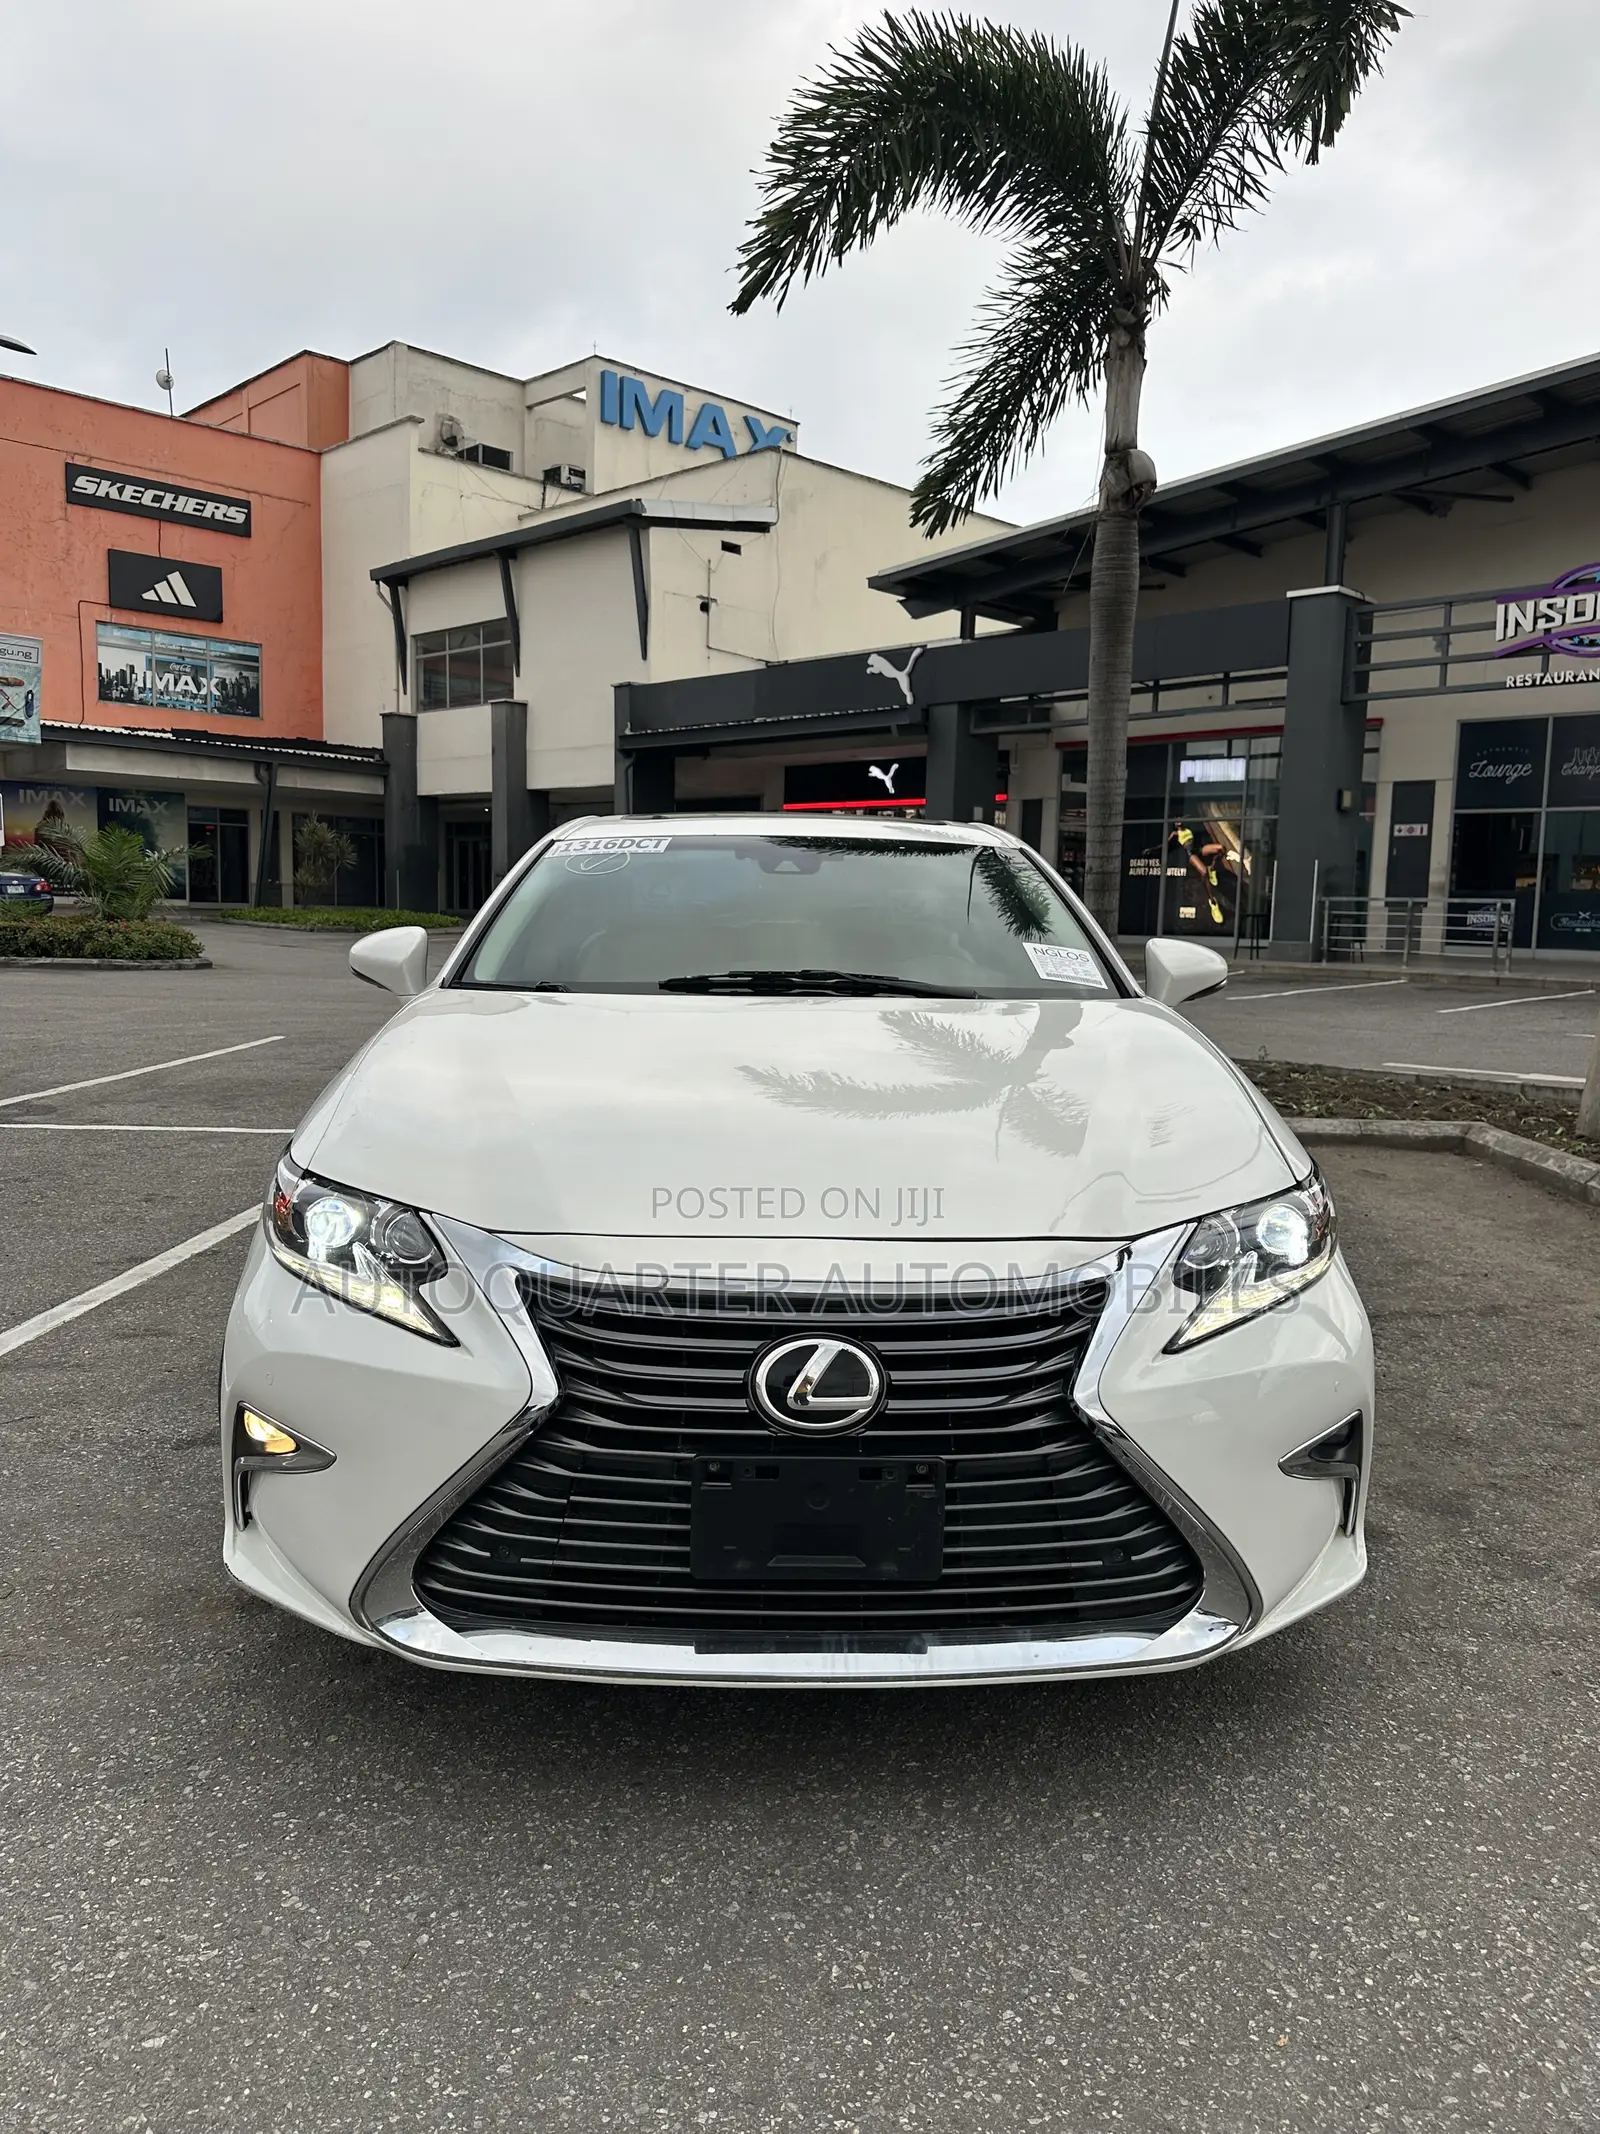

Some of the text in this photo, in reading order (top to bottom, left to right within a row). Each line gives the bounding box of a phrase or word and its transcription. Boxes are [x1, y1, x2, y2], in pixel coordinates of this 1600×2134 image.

[601, 369, 788, 460] IMAX
[72, 475, 248, 524] SKECHERS
[1495, 593, 1600, 642] INSO
[1469, 760, 1533, 785] Lounge
[19, 788, 87, 808] IMAX
[108, 797, 169, 815] IMAX
[560, 838, 668, 853] 1316DCT
[1033, 946, 1090, 963] NGLOS
